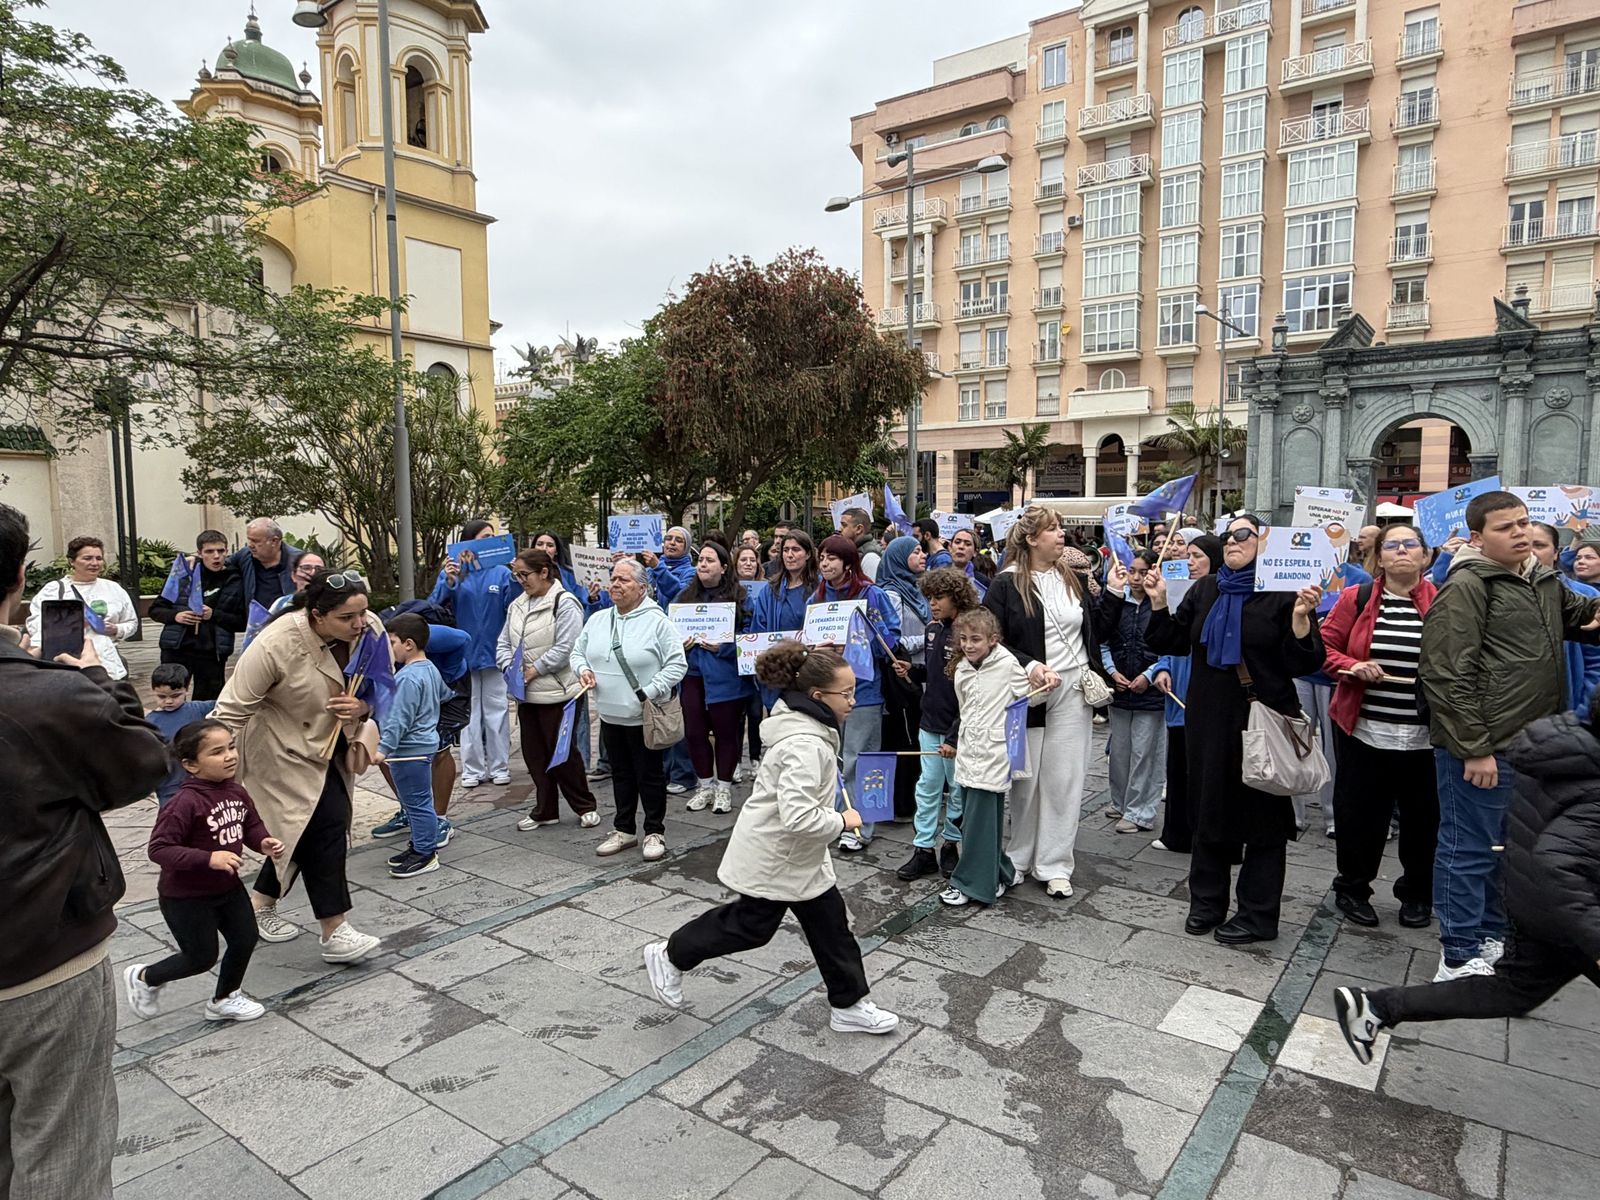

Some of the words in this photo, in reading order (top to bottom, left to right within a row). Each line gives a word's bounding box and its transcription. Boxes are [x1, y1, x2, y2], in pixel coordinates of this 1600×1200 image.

[1262, 559, 1273, 567] NO
[1274, 559, 1283, 567] ES
[1284, 559, 1313, 568] ESPERA,
[1313, 560, 1322, 568] ES
[1274, 571, 1311, 580] ABANDONO
[219, 823, 243, 846] CLUB
